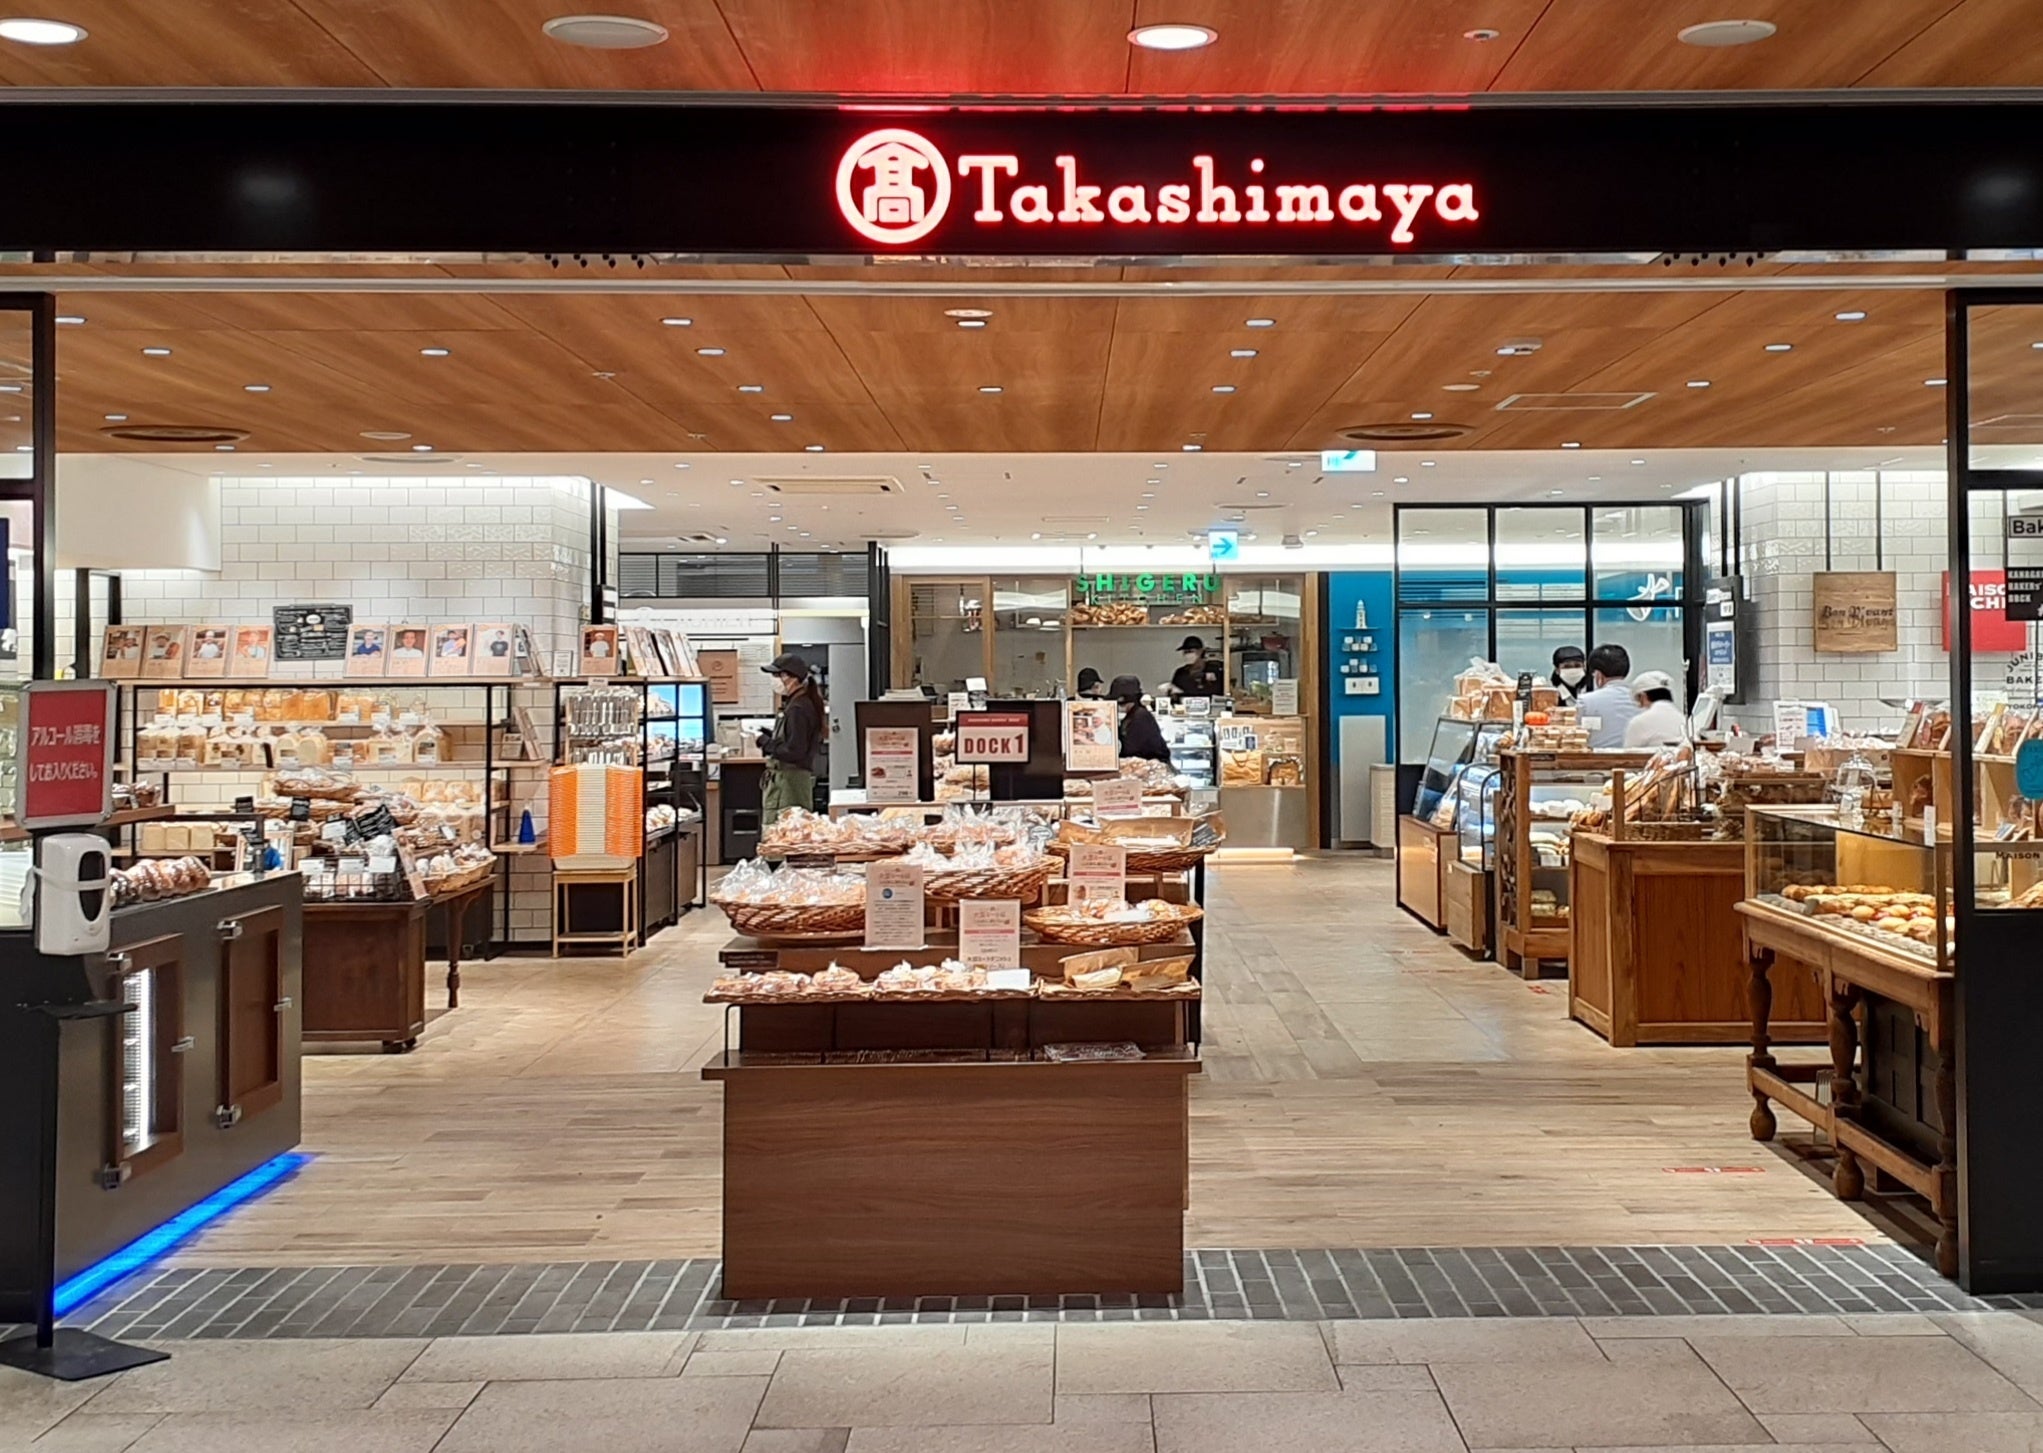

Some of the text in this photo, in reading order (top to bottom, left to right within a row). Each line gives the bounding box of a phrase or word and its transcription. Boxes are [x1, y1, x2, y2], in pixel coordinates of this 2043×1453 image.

[957, 155, 1480, 244] Takashimaya
[1076, 572, 1221, 593] SHIGERU
[1091, 594, 1203, 605] KITCHEN
[964, 733, 1024, 754] DOCK 1
[1995, 851, 2041, 860] MAISON
